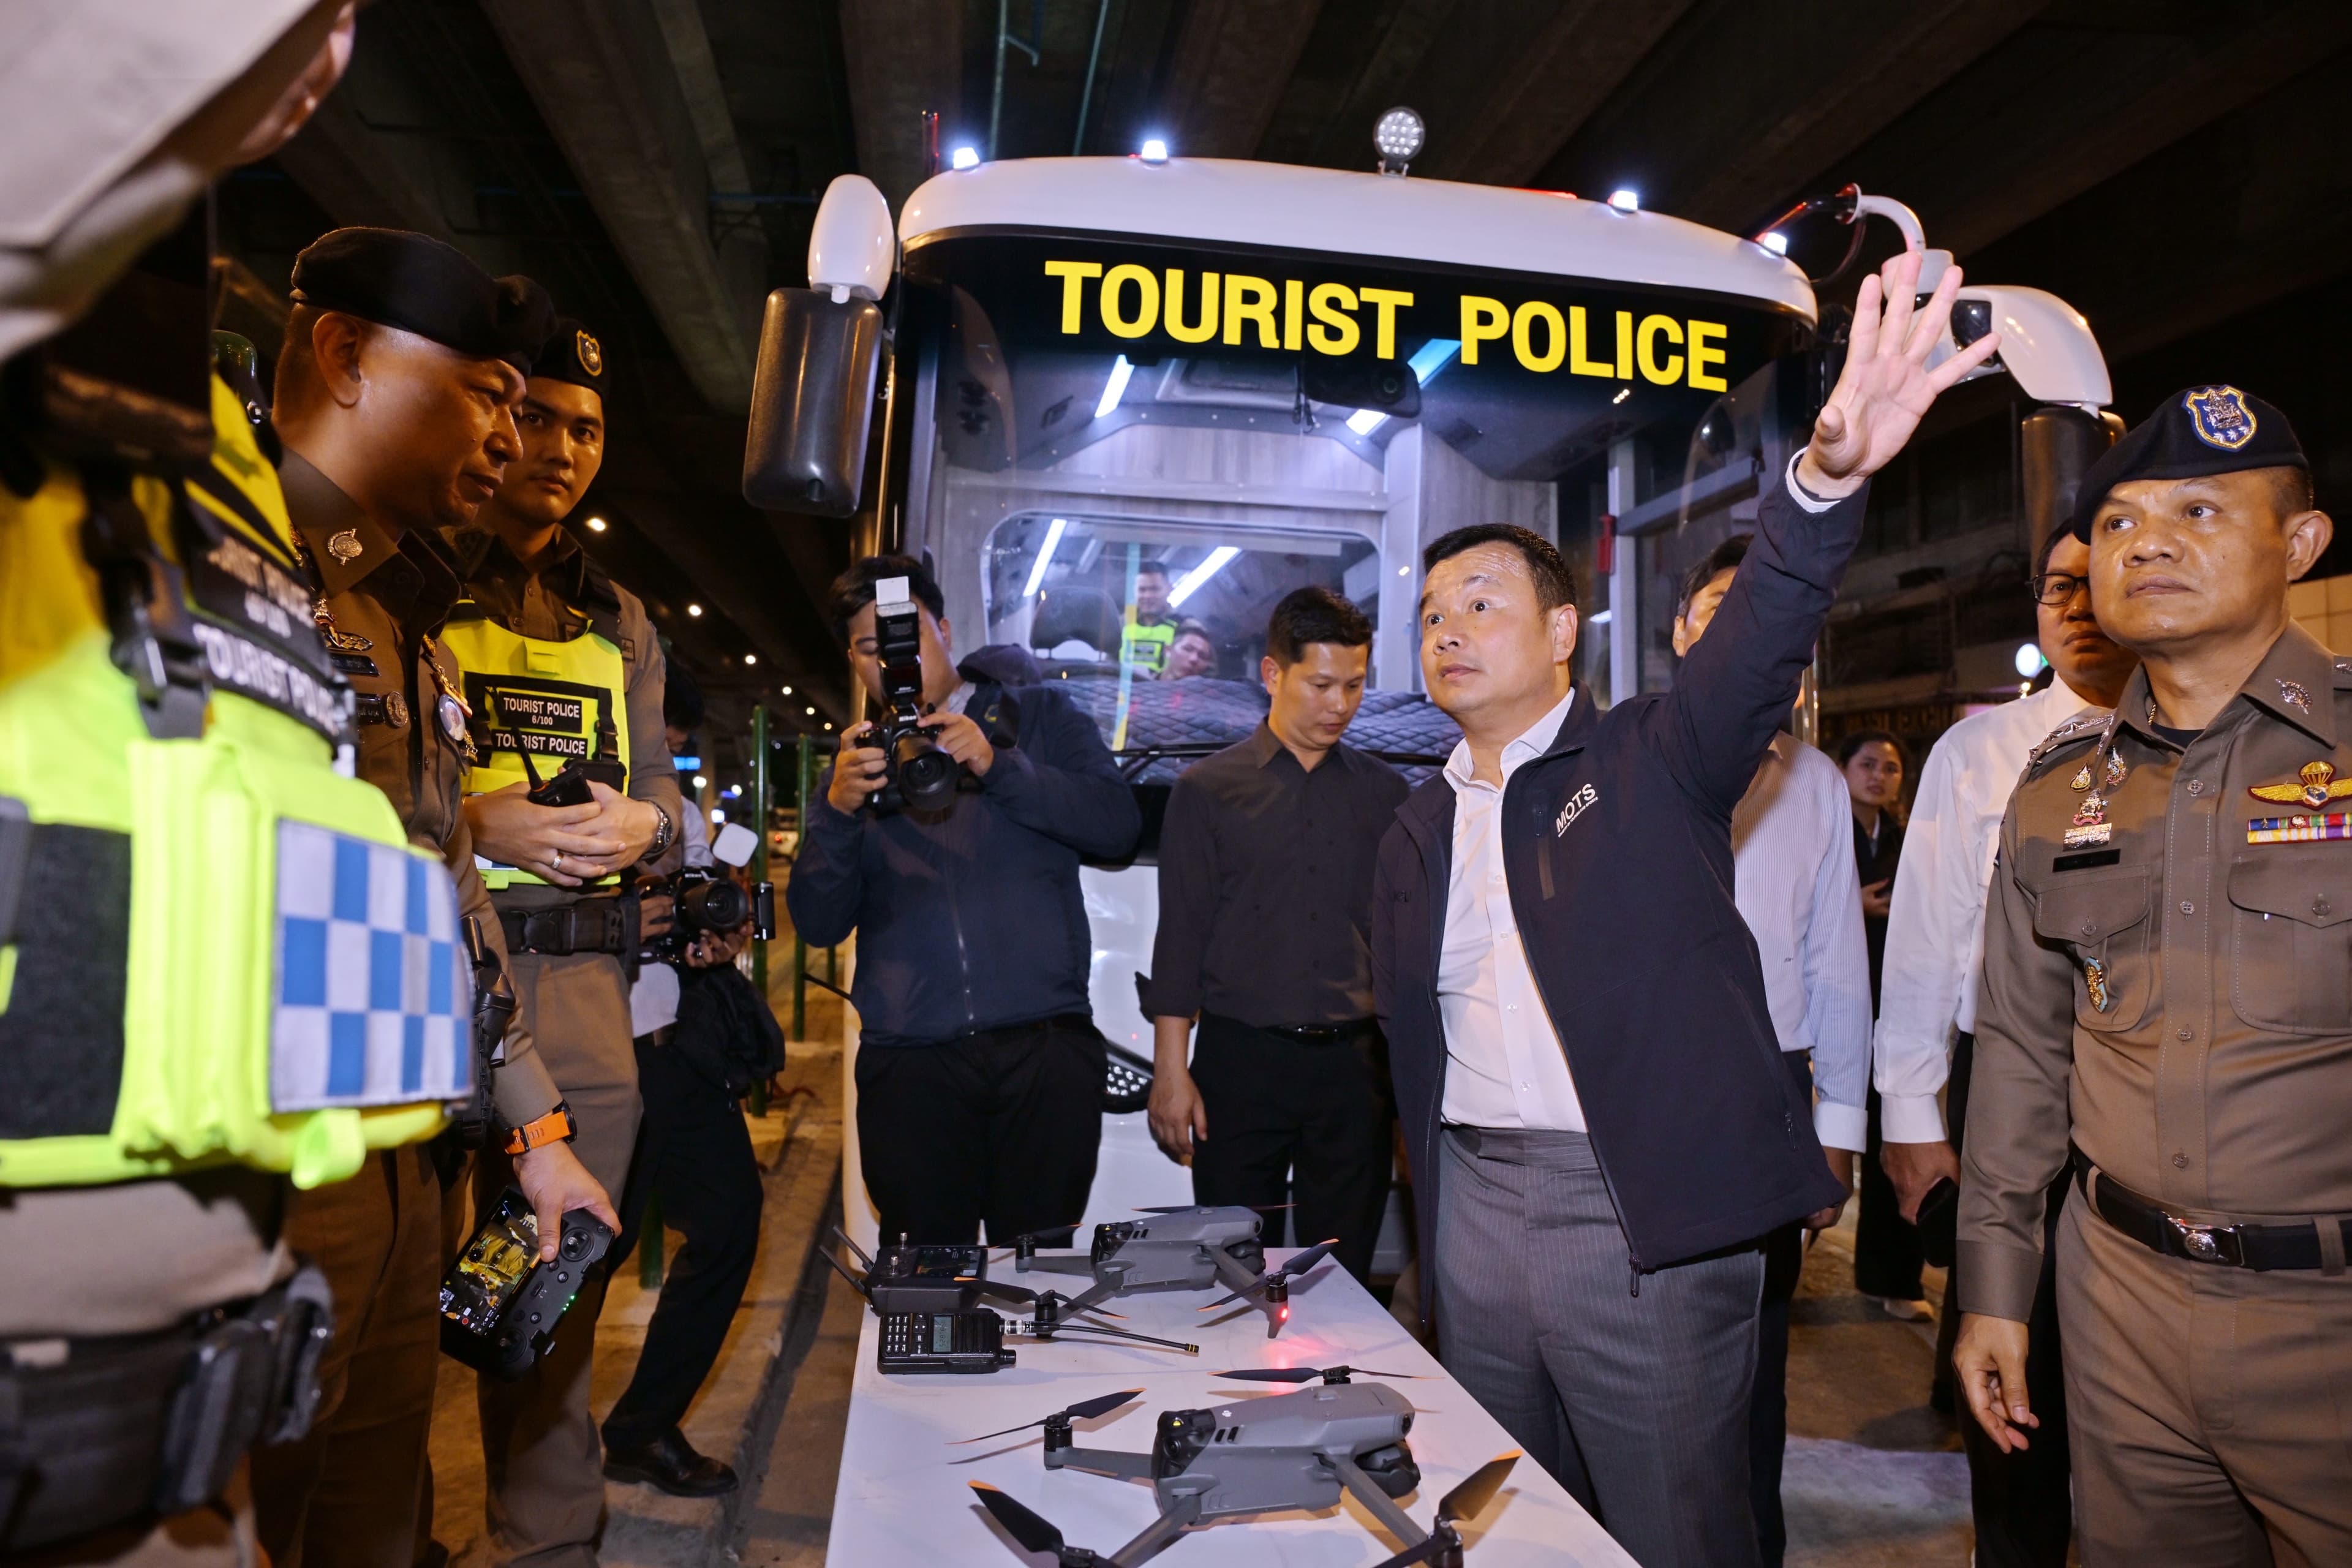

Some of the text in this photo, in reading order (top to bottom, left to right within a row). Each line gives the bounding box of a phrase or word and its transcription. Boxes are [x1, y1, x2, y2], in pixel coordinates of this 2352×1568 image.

[1044, 260, 1728, 392] TOURIST POLICE
[503, 697, 580, 718] TOURIST POLICE
[532, 715, 553, 725] 6/100
[549, 737, 586, 755] POLICE
[1556, 783, 1596, 833] MOTS
